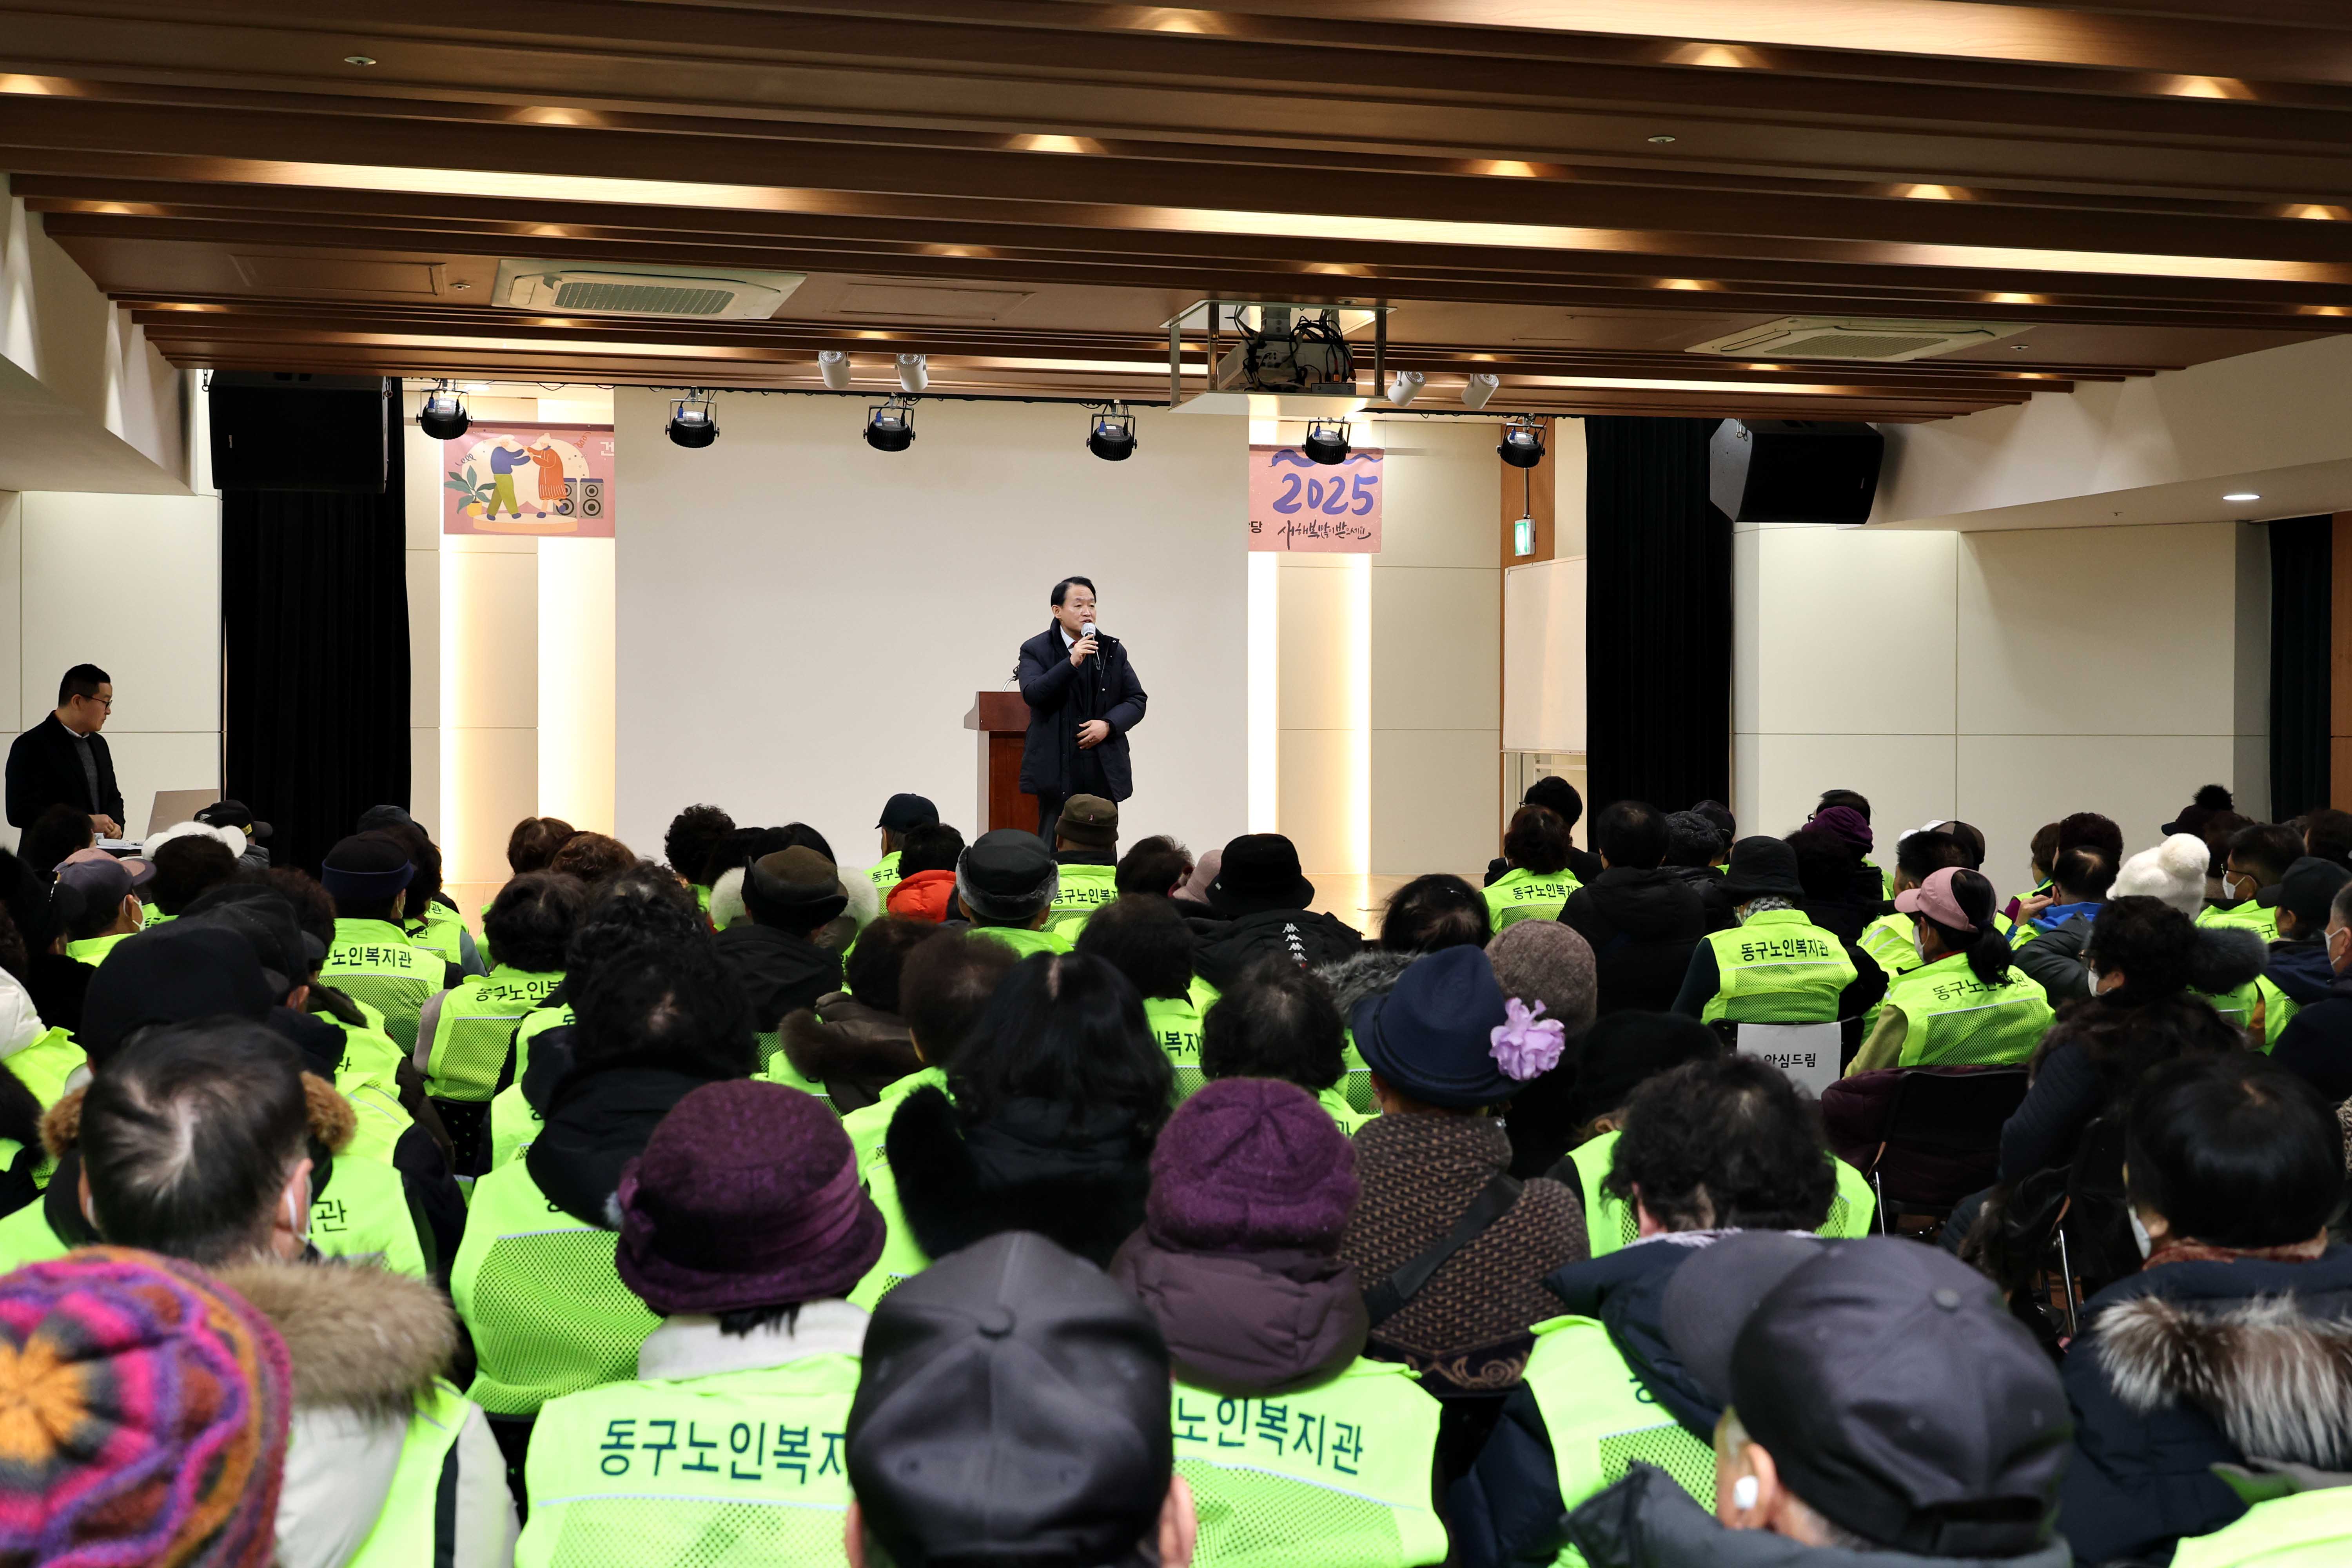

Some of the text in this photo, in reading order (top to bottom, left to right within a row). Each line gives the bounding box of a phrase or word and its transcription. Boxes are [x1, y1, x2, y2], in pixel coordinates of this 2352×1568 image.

[1273, 473, 1378, 515] 2025
[1249, 521, 1263, 534] 당
[1513, 883, 1578, 900] 동구노인복지
[428, 903, 443, 914] 관
[327, 947, 412, 968] 노인복지관
[1741, 938, 1829, 962] 동구노인복지관
[310, 1199, 347, 1234] 관
[1172, 1398, 1363, 1475] 노인복지관
